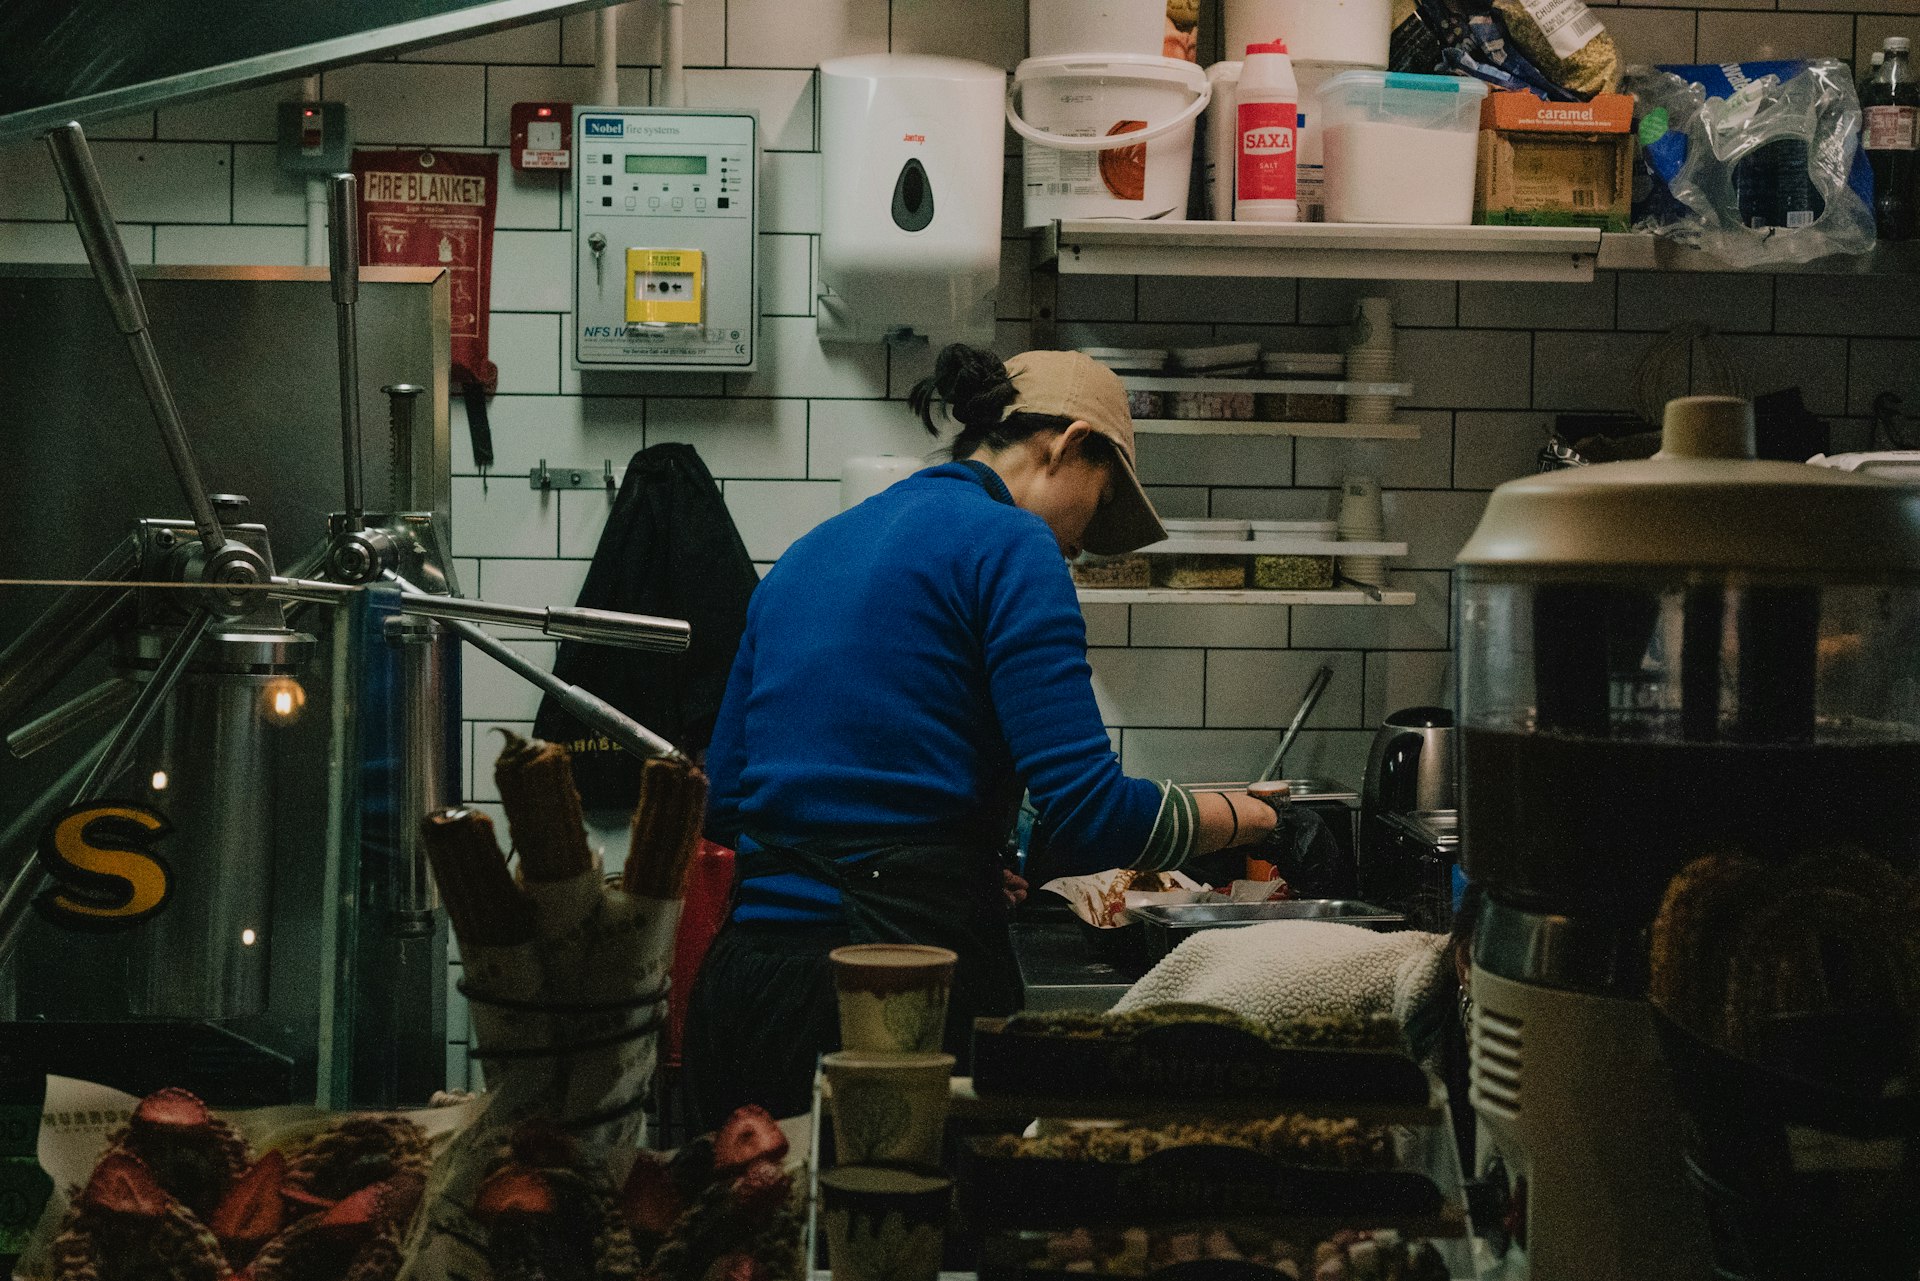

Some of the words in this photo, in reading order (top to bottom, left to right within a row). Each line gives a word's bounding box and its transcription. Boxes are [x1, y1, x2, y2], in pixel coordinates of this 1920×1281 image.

[1537, 108, 1593, 120] caramel
[591, 124, 622, 134] Nobel
[626, 124, 643, 134] fire
[644, 126, 680, 136] systems
[1246, 134, 1290, 148] SAXA
[368, 173, 402, 200] FIRE
[408, 174, 481, 203] BLANKET
[584, 327, 610, 338] NFS
[614, 327, 628, 338] IV
[53, 806, 167, 918] S
